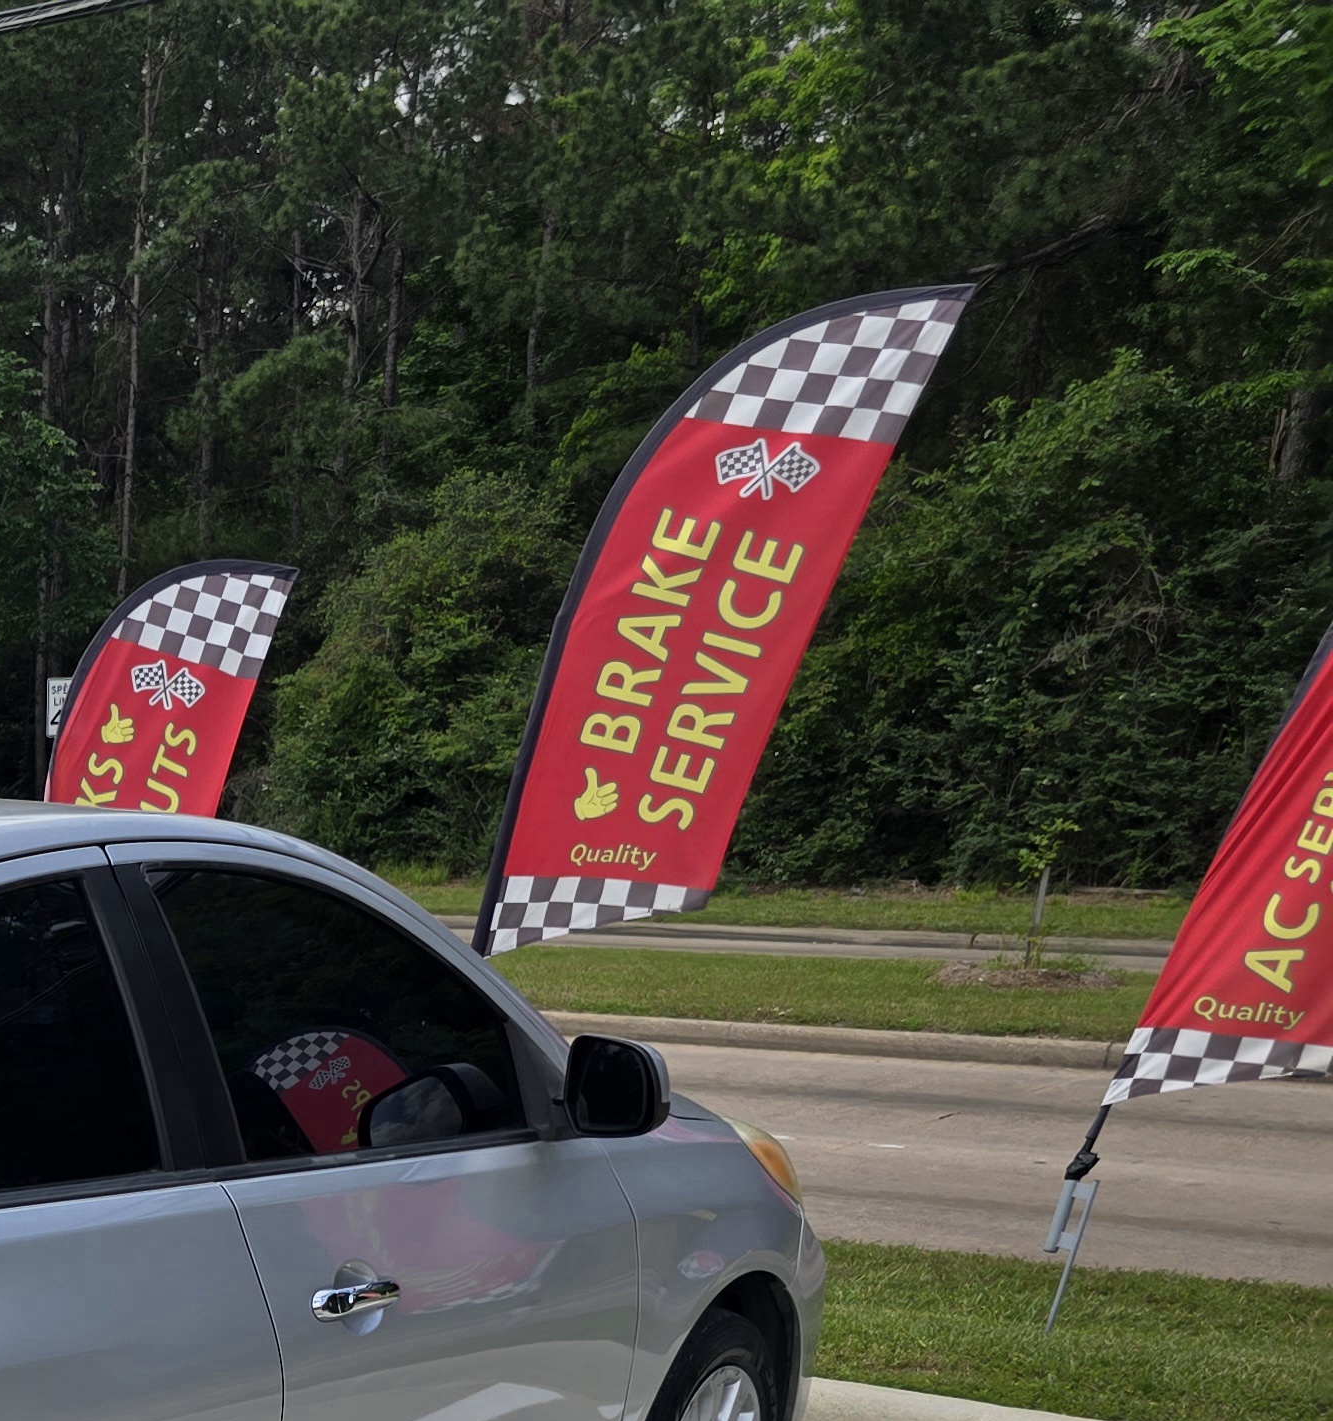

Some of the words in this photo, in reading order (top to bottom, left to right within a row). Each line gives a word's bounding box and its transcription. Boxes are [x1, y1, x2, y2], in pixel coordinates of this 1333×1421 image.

[580, 507, 721, 754] BRAKE
[638, 530, 803, 830] SERVICE
[140, 722, 197, 813] UTS
[569, 843, 657, 871] Quality
[1244, 893, 1320, 994] AC
[1283, 771, 1333, 884] SER
[1194, 995, 1305, 1030] Quality
